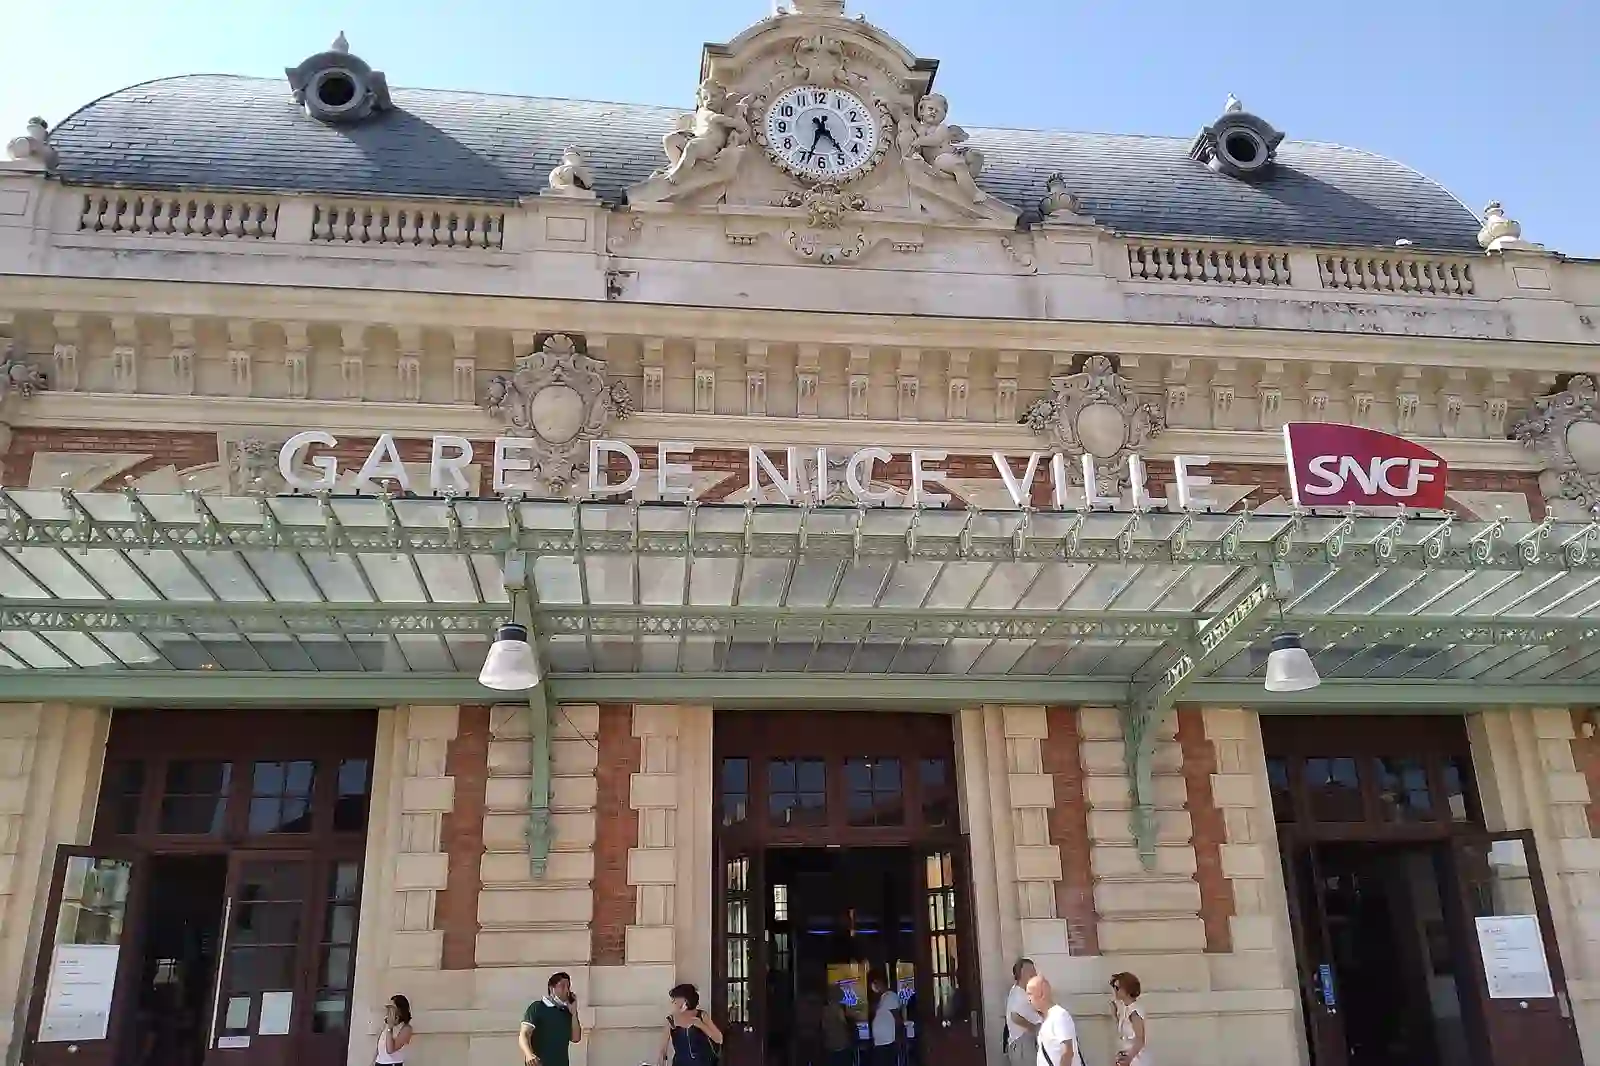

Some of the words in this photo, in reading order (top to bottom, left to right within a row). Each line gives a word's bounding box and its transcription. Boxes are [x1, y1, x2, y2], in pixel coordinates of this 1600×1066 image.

[797, 95, 806, 107] 11
[814, 92, 827, 104] 12
[837, 99, 841, 109] 1
[781, 106, 793, 117] 10
[849, 111, 857, 122] 2
[778, 121, 787, 133] 9
[855, 127, 864, 139] 3
[783, 138, 792, 149] 8
[850, 143, 859, 154] 4
[799, 151, 806, 163] 7
[817, 156, 826, 168] 6
[836, 154, 845, 165] 5
[278, 430, 536, 495] GARE
[588, 439, 695, 495] DE
[748, 444, 952, 506] NICE
[992, 452, 1217, 509] VILLE
[1304, 455, 1439, 497] SNCF
